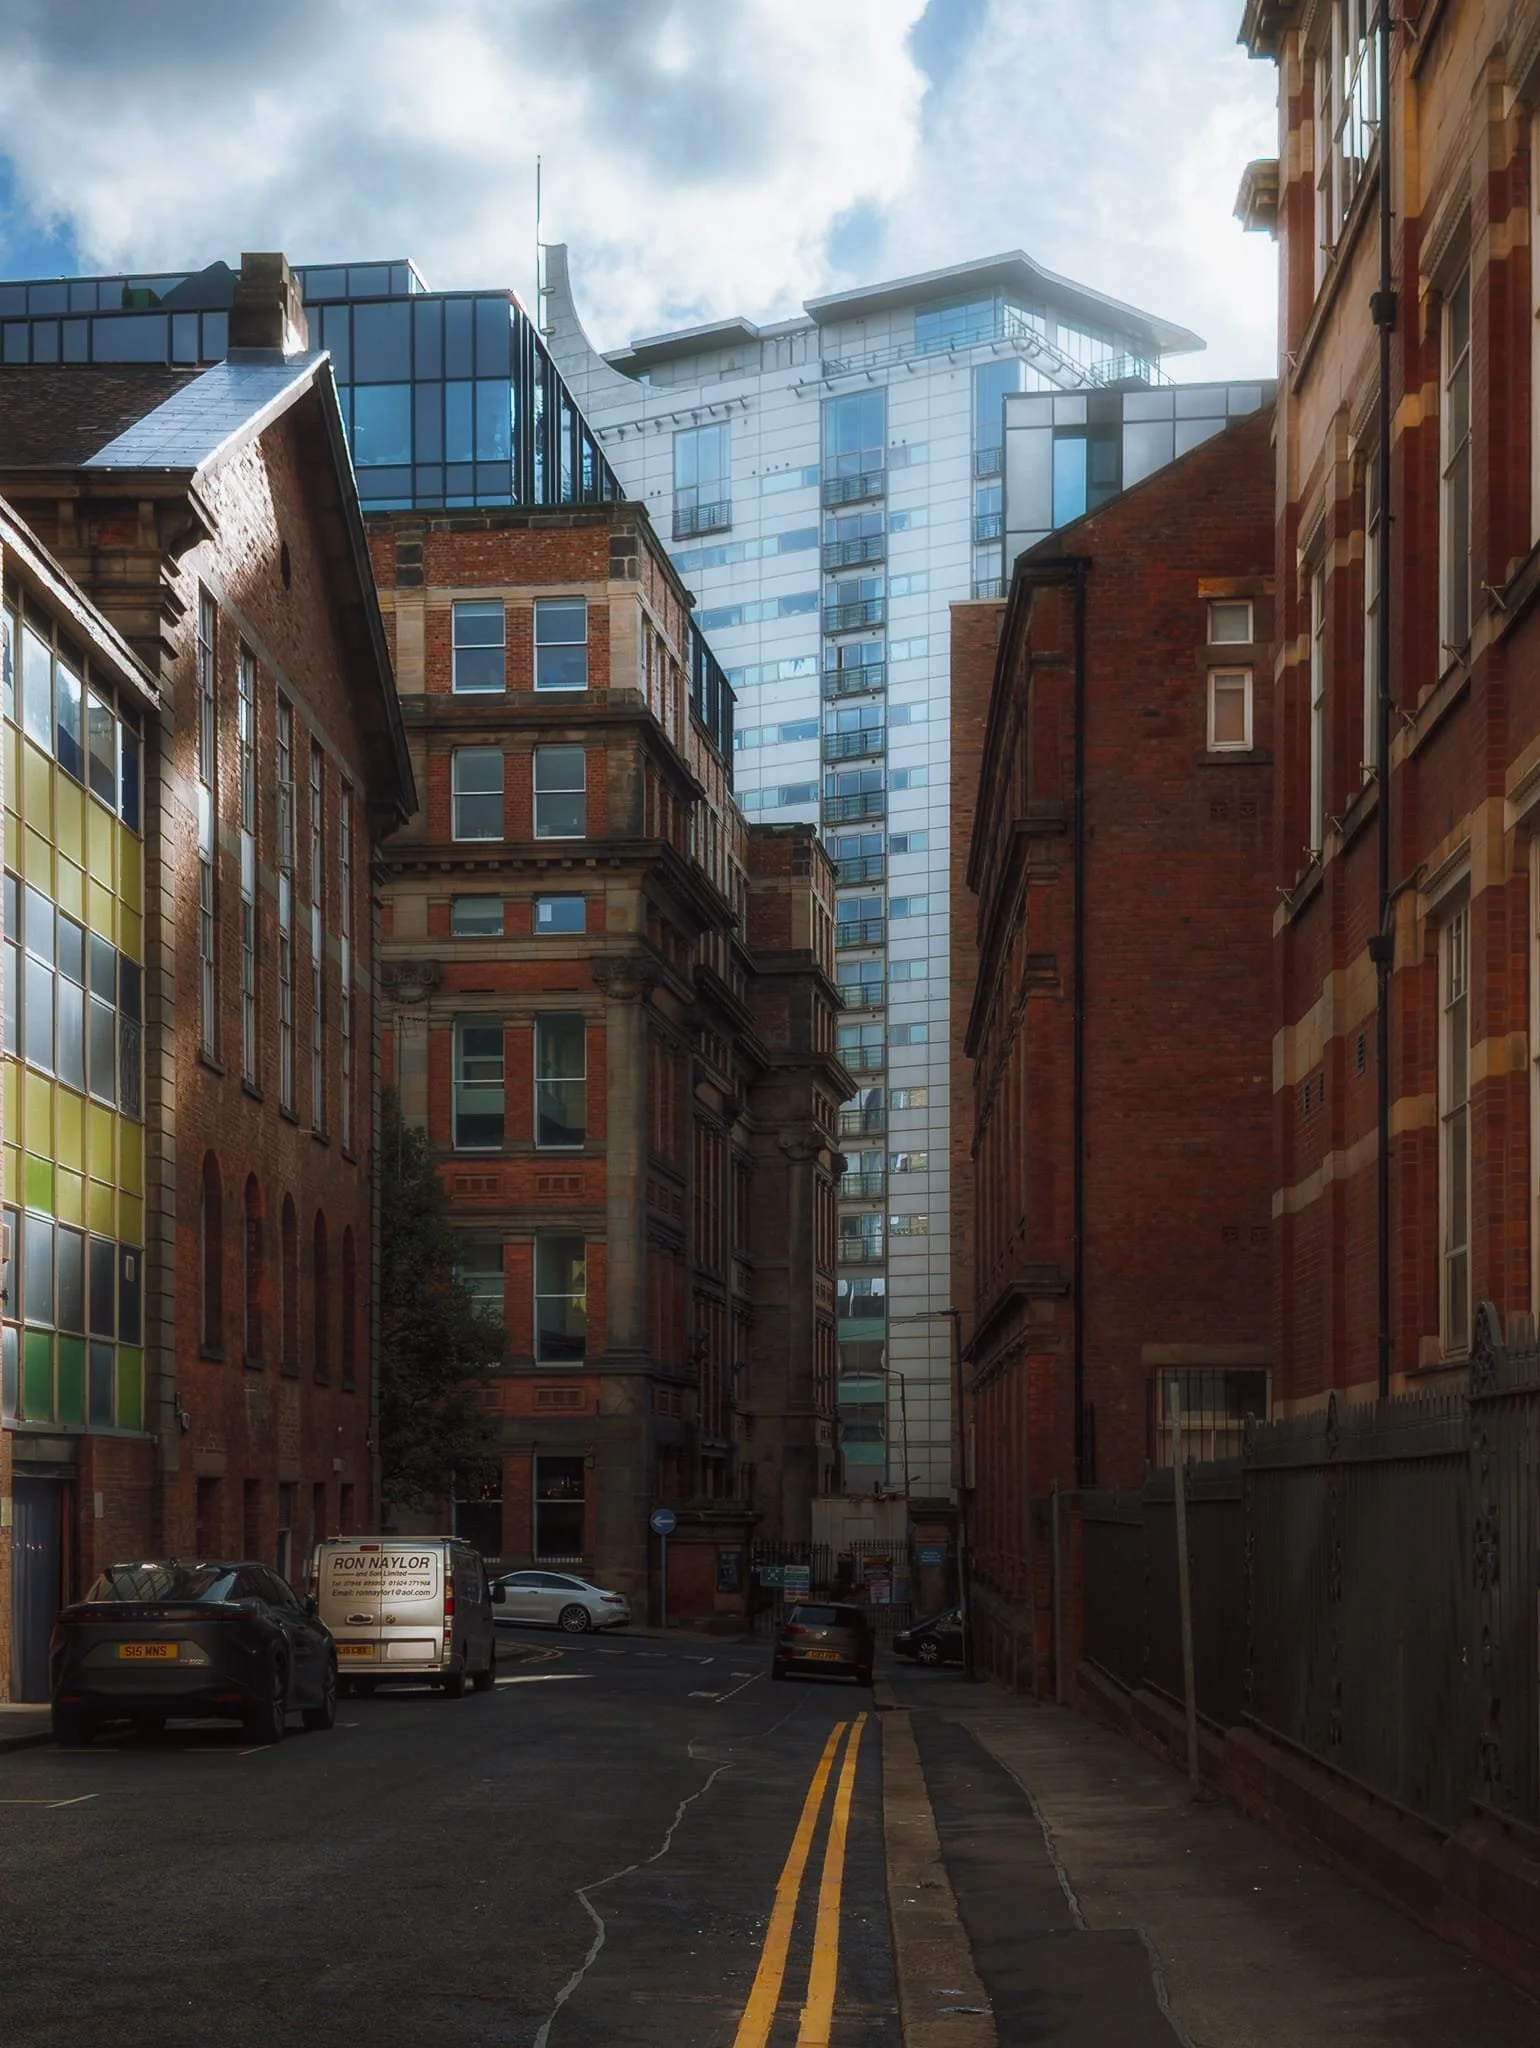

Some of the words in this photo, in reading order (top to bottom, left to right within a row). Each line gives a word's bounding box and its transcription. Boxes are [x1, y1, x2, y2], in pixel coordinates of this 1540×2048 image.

[333, 1557, 365, 1569] RON
[369, 1557, 430, 1569] NAYLOR
[332, 1589, 354, 1597] Email:
